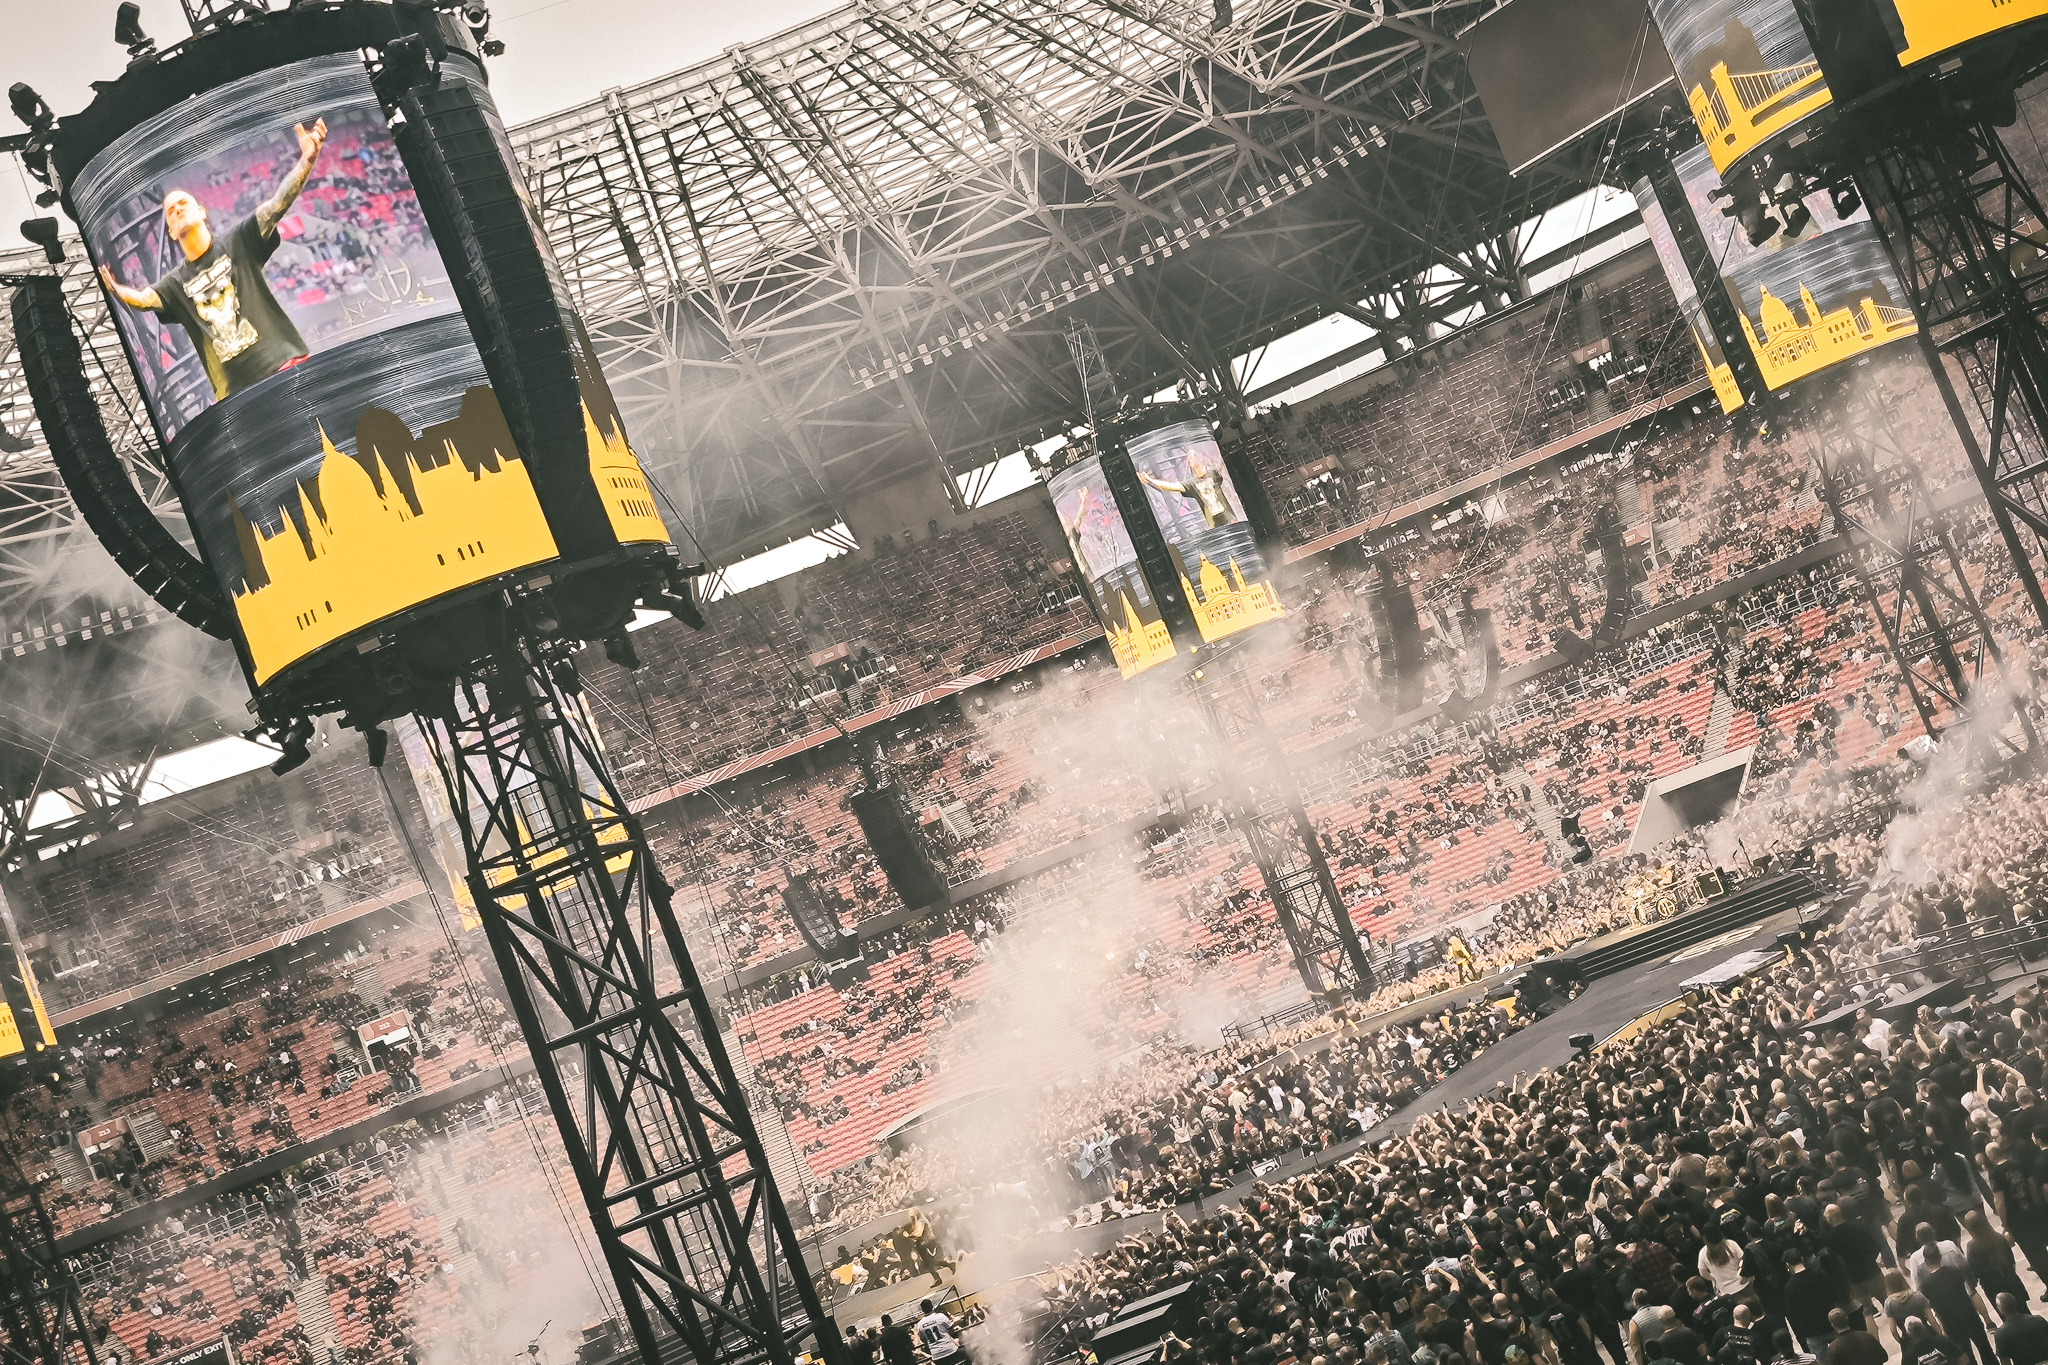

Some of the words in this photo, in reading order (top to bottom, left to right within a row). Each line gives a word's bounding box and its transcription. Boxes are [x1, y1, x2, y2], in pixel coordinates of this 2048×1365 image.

[1624, 533, 1636, 543] 207
[378, 1021, 391, 1031] 212
[97, 1127, 112, 1138] 213
[179, 1349, 203, 1364] ONLY
[203, 1341, 224, 1355] EXIT
